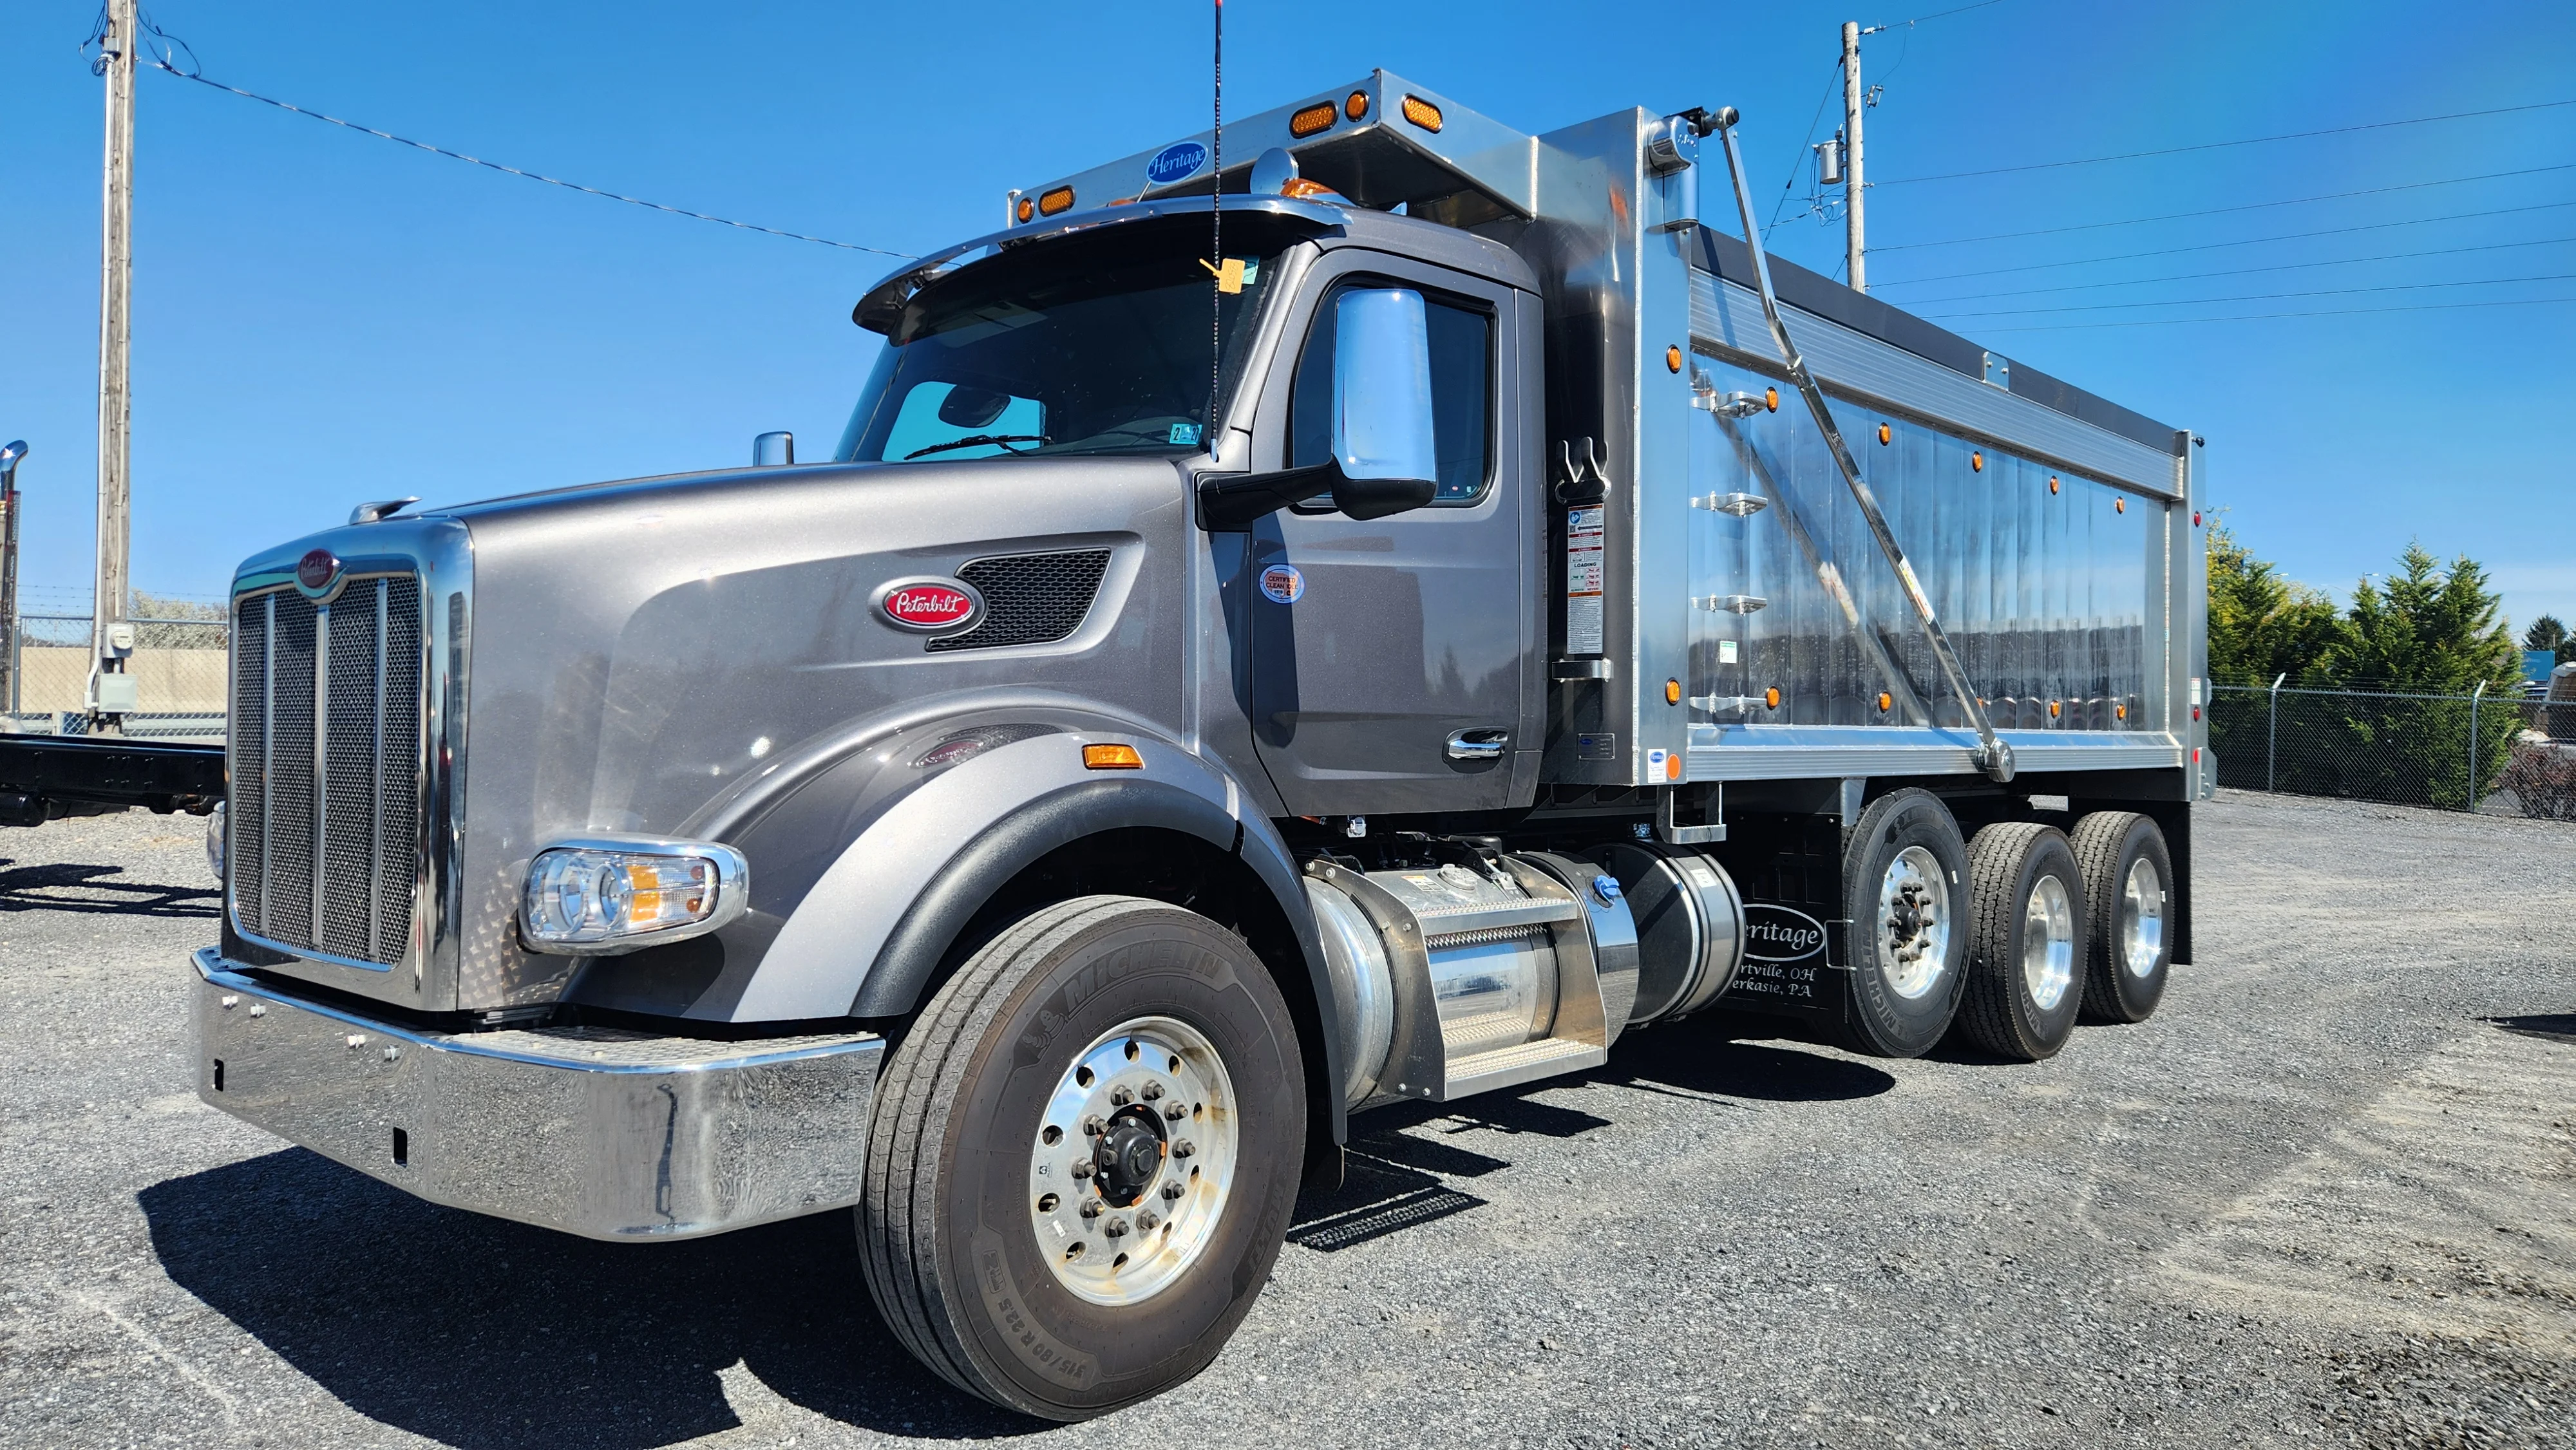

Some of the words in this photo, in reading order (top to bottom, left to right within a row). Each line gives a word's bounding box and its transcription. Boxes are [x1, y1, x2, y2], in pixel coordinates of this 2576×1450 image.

[1150, 149, 1204, 177] Heritage
[1173, 427, 1180, 441] 2
[301, 556, 332, 579] Peterbilt
[896, 592, 964, 615] Peterbilt
[1746, 921, 1819, 950] ritage
[1063, 942, 1224, 1013] MICHELIN
[1740, 963, 1786, 980] rtville,
[1790, 967, 1818, 982] OH
[1732, 977, 1784, 995] erkasie,
[1788, 983, 1812, 997] PA
[998, 1297, 1027, 1333] 22.5
[1020, 1330, 1036, 1348] R
[1032, 1342, 1087, 1379] 315/80
